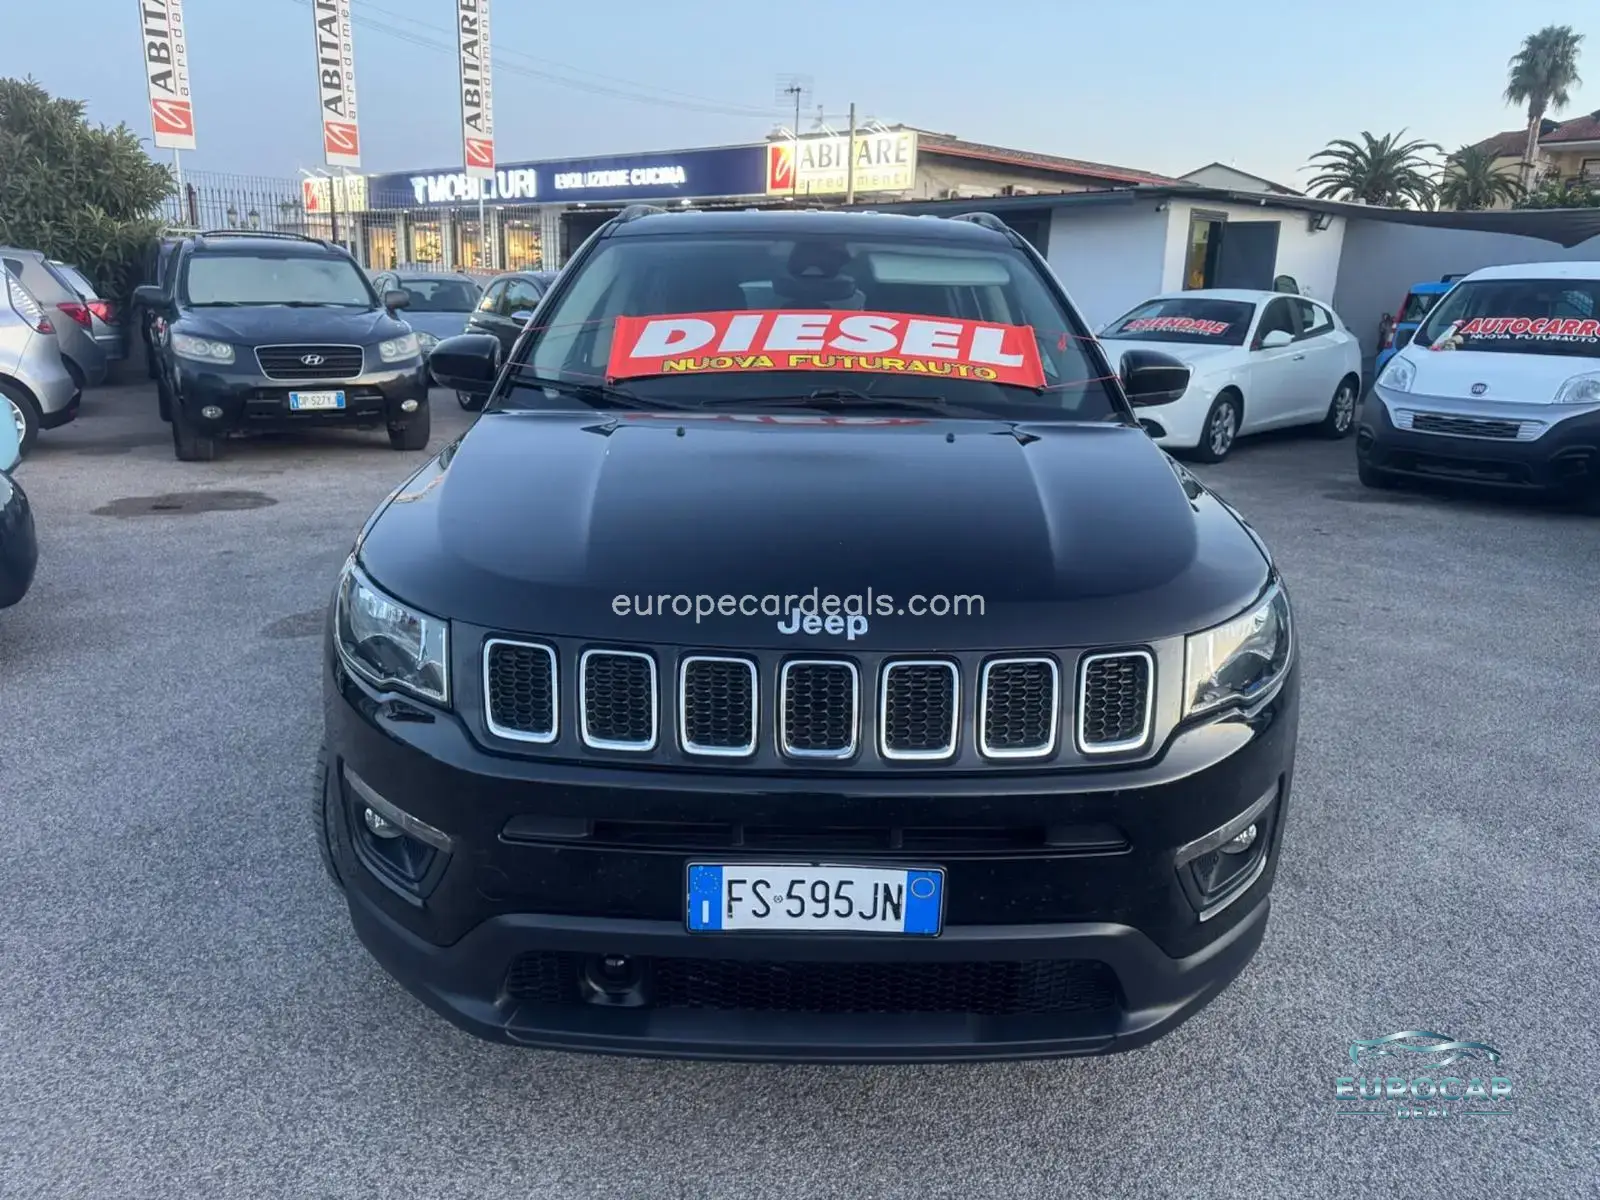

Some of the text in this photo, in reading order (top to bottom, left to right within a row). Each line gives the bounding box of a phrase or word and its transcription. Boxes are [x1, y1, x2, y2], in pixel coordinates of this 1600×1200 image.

[171, 0, 189, 96] arreda
[801, 137, 908, 171] ABIARE
[317, 178, 364, 196] ABTRE
[799, 171, 908, 189] arredmenti
[629, 313, 1024, 368] DIESEL
[1460, 317, 1600, 338] AUTOCARR
[1515, 333, 1598, 344] FUTURAUTO
[662, 353, 999, 382] NUOVA FUTURAUTO
[777, 608, 869, 641] Jeep
[727, 879, 771, 919] FS
[786, 879, 903, 921] 595JN
